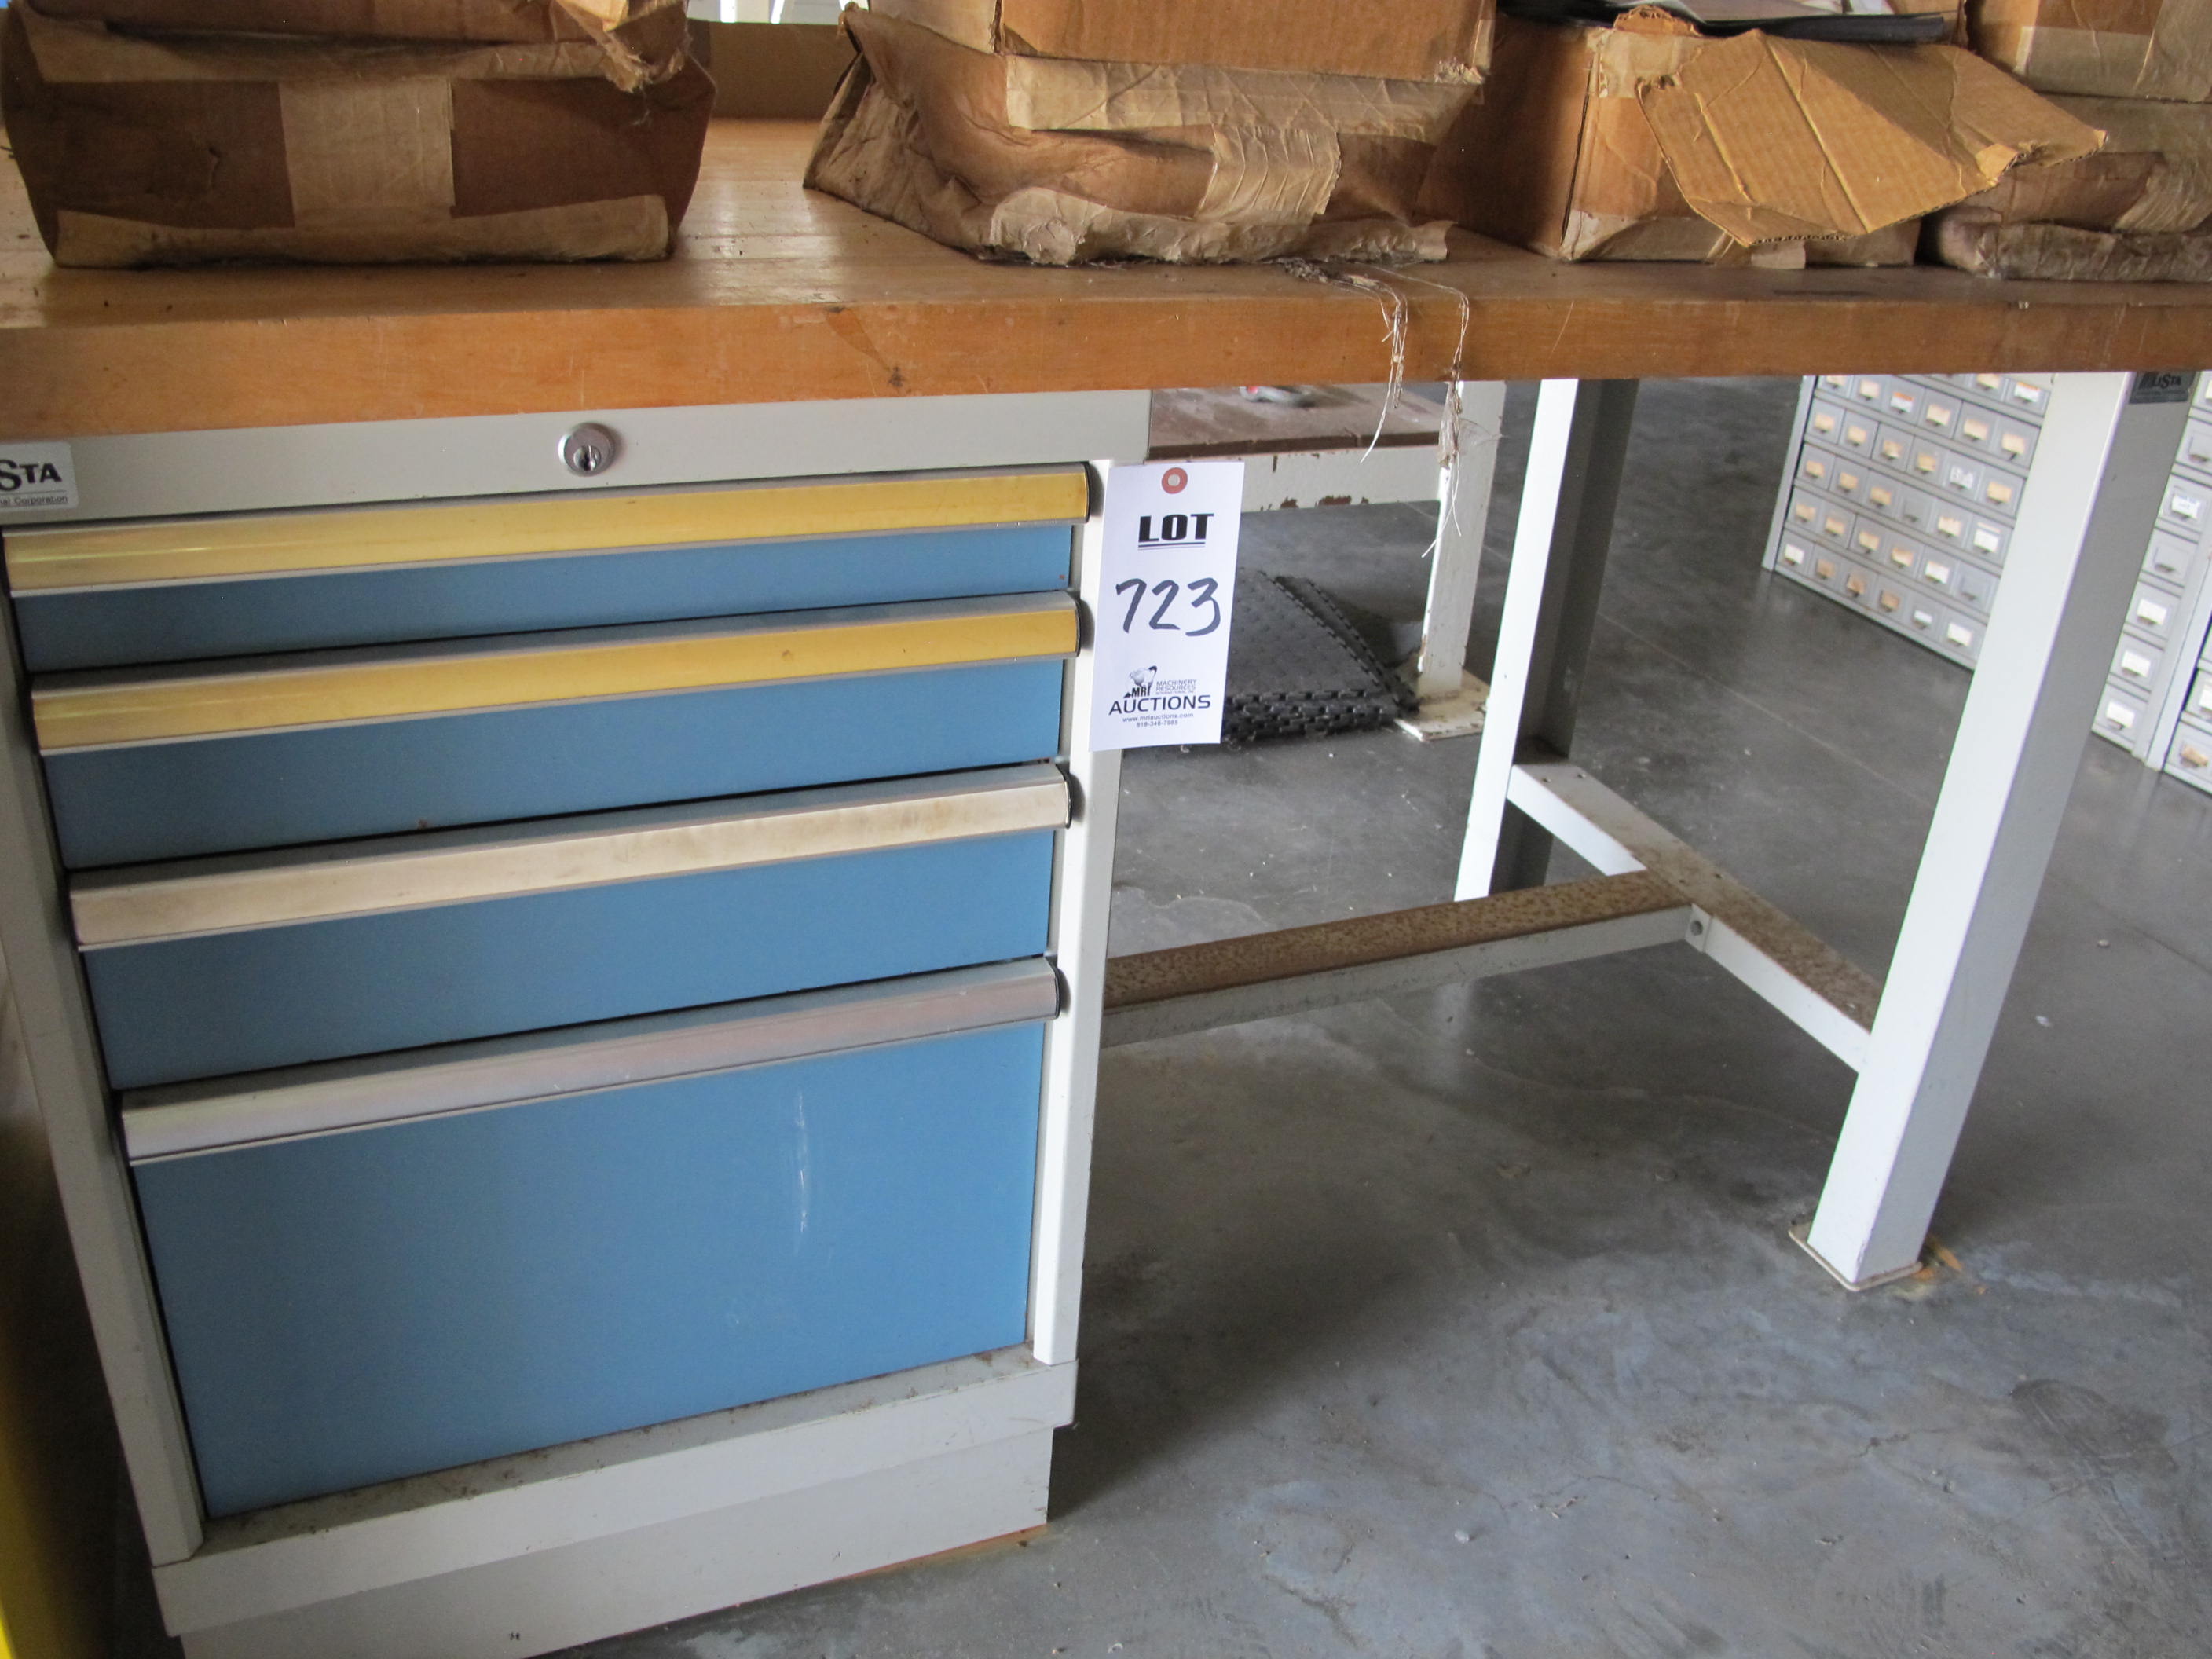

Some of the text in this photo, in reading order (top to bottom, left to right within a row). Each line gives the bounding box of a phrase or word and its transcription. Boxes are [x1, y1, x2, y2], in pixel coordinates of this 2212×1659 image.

[14, 495, 69, 505] Corporation
[1138, 513, 1214, 543] LOT
[1115, 577, 1221, 637] 723
[1131, 685, 1152, 698] MRI
[1108, 694, 1211, 716] AUCTIONS
